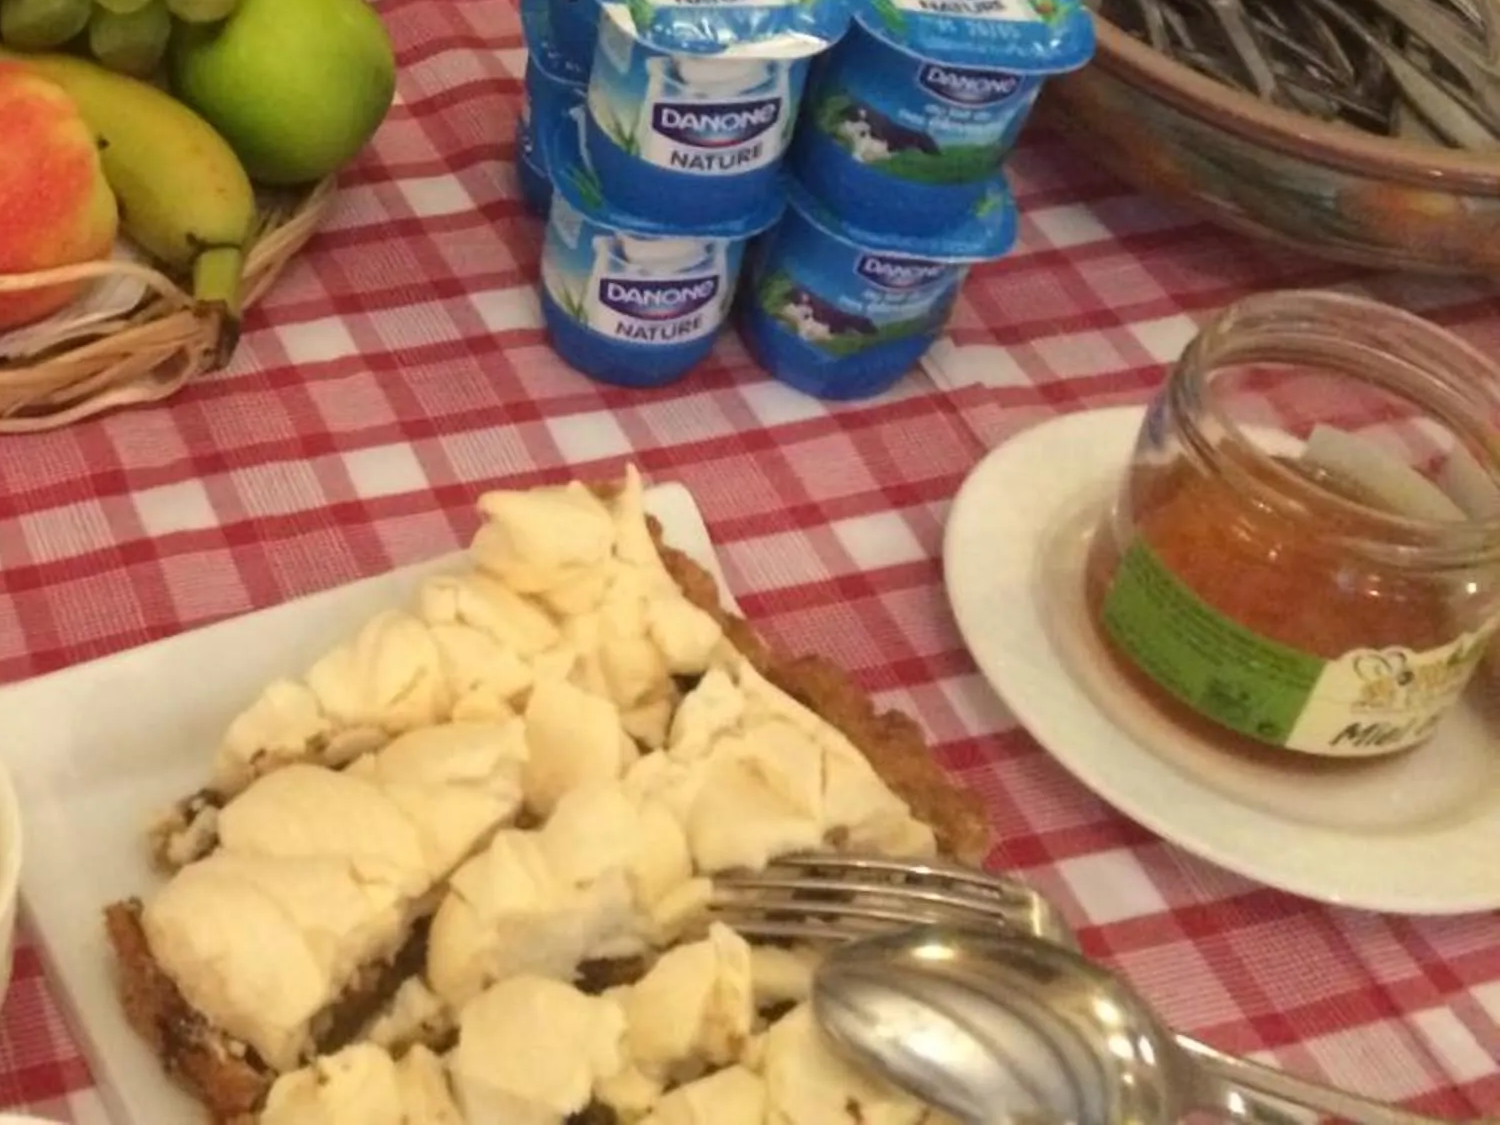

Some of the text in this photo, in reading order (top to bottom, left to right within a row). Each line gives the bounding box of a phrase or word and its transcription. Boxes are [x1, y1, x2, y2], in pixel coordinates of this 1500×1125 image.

[927, 66, 1017, 93] DANONE
[661, 103, 776, 132] DANONE
[669, 142, 763, 171] NATURE
[607, 279, 714, 306] DANONE
[614, 315, 701, 341] NATURE
